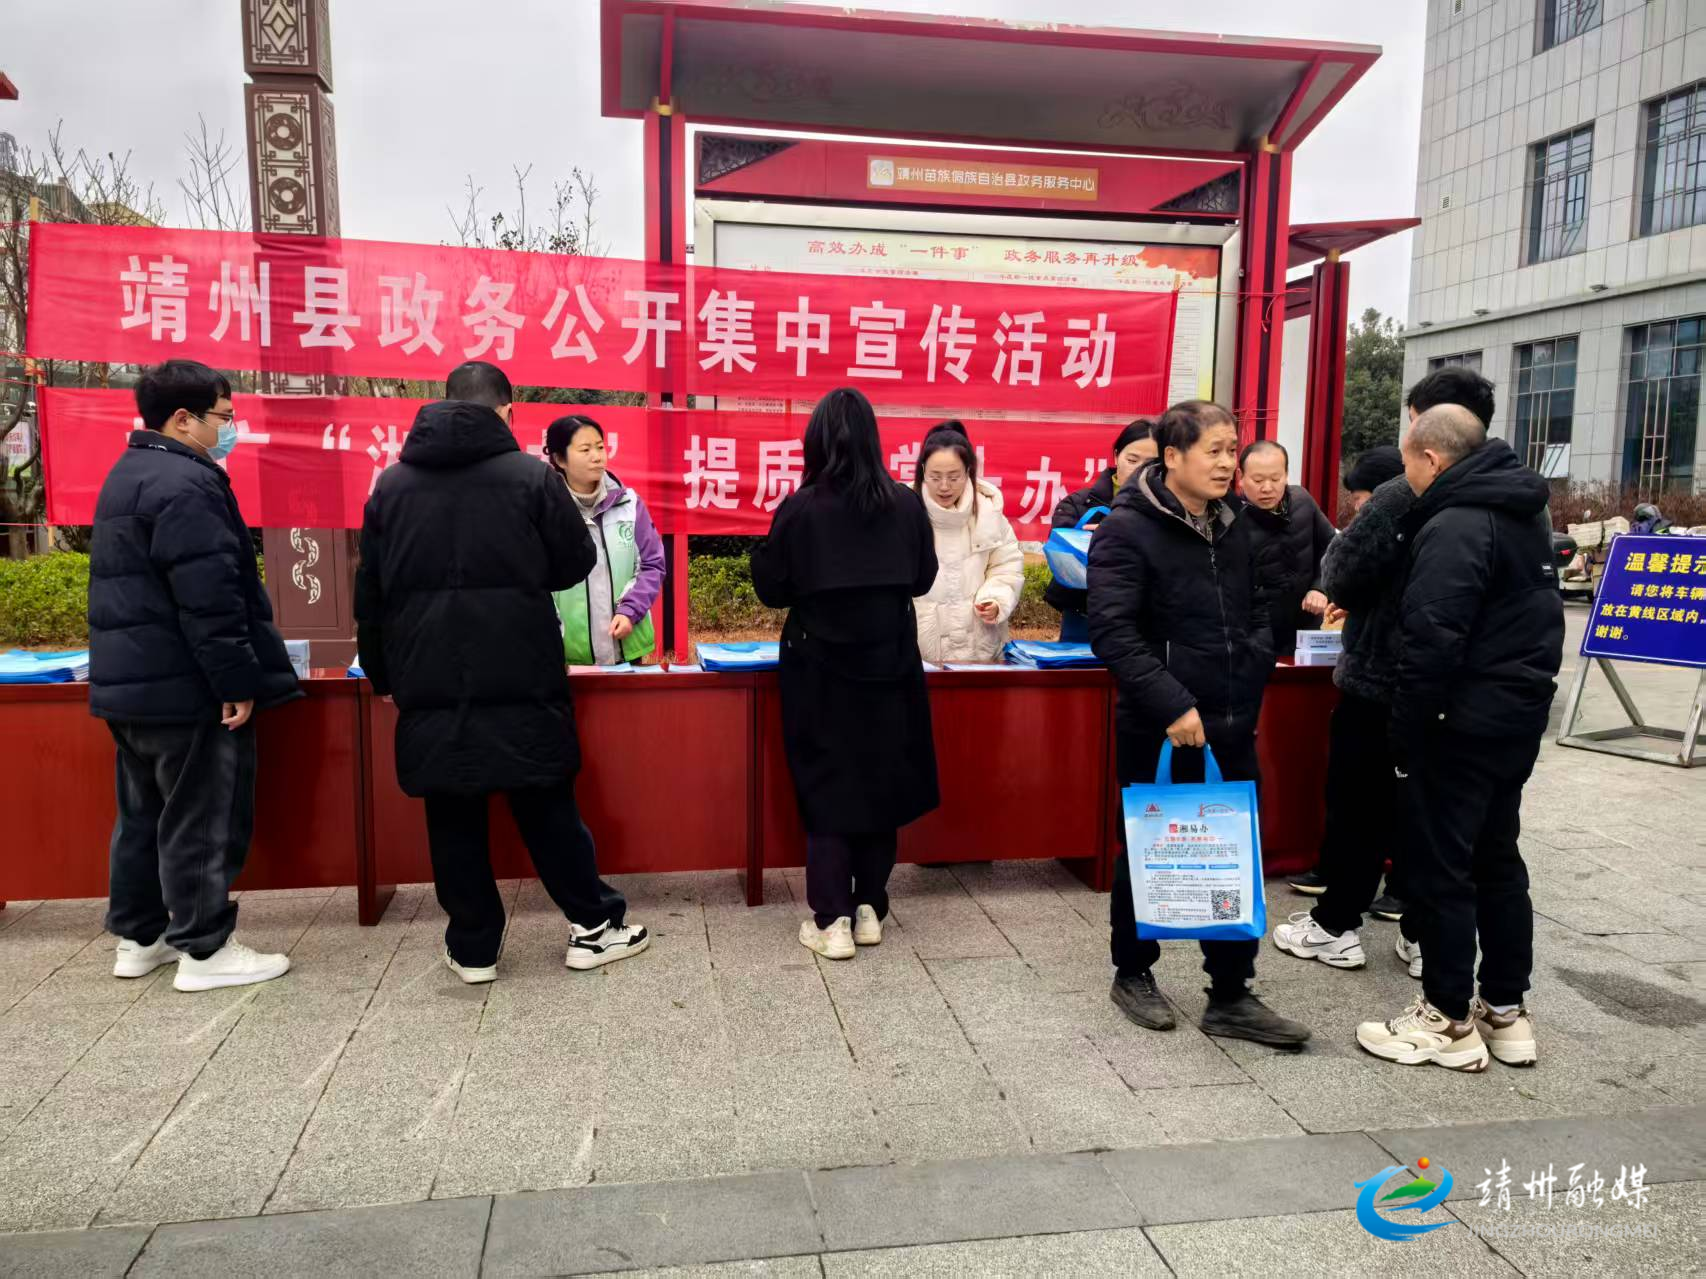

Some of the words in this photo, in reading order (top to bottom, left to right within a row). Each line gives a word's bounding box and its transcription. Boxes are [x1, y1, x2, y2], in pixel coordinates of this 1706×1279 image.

[896, 166, 1095, 192] 靖州苗族侗族自治县政务服务中心
[1003, 248, 1139, 267] 政务服务再升级
[119, 254, 1117, 389] 靖州县政务公开集中宣传活动
[1624, 551, 1706, 575] 温馨提示
[1630, 583, 1706, 600] 请您将车辆
